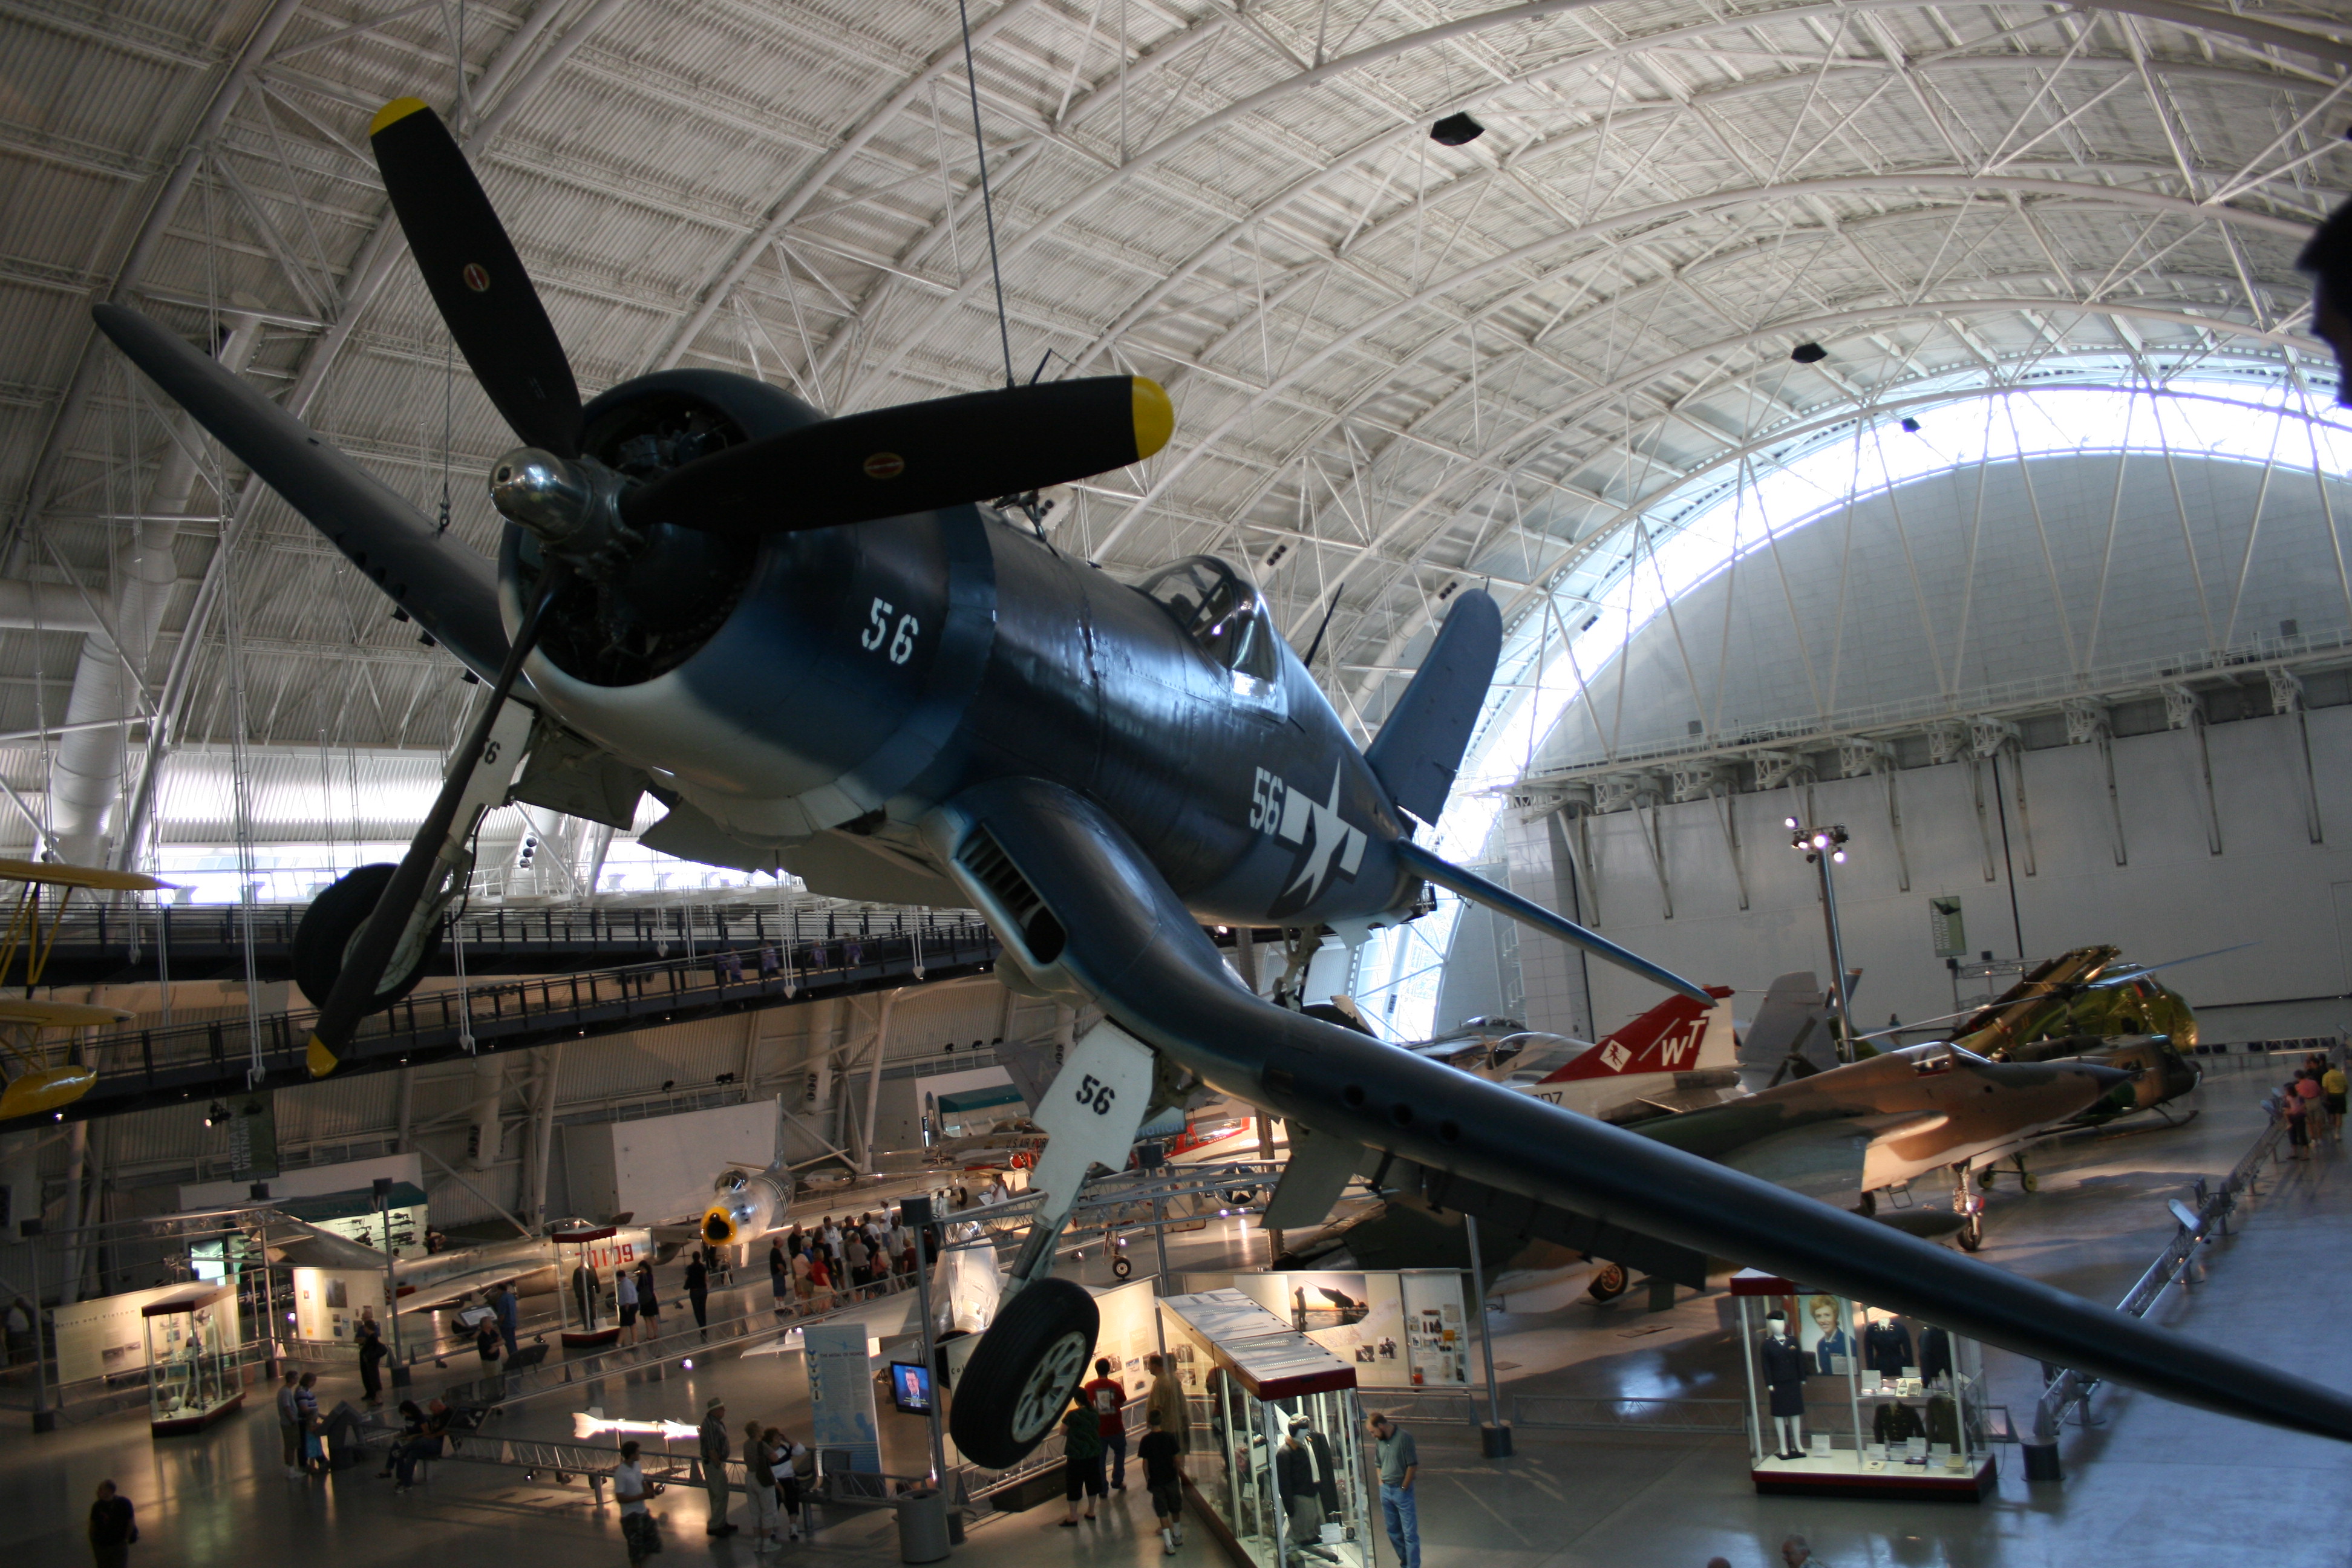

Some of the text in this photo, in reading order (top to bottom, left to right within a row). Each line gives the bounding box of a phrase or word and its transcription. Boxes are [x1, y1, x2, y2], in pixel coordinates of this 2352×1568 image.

[862, 596, 918, 664] 56
[1250, 766, 1283, 835] 56
[1931, 909, 1943, 950] MODERN
[1076, 1073, 1115, 1115] 56
[1532, 1091, 1563, 1105] 07
[230, 1130, 241, 1171] KOREA
[239, 1116, 252, 1169] VIETNAM
[1019, 1137, 1030, 1148] AIR
[103, 1309, 136, 1318] Vietnam
